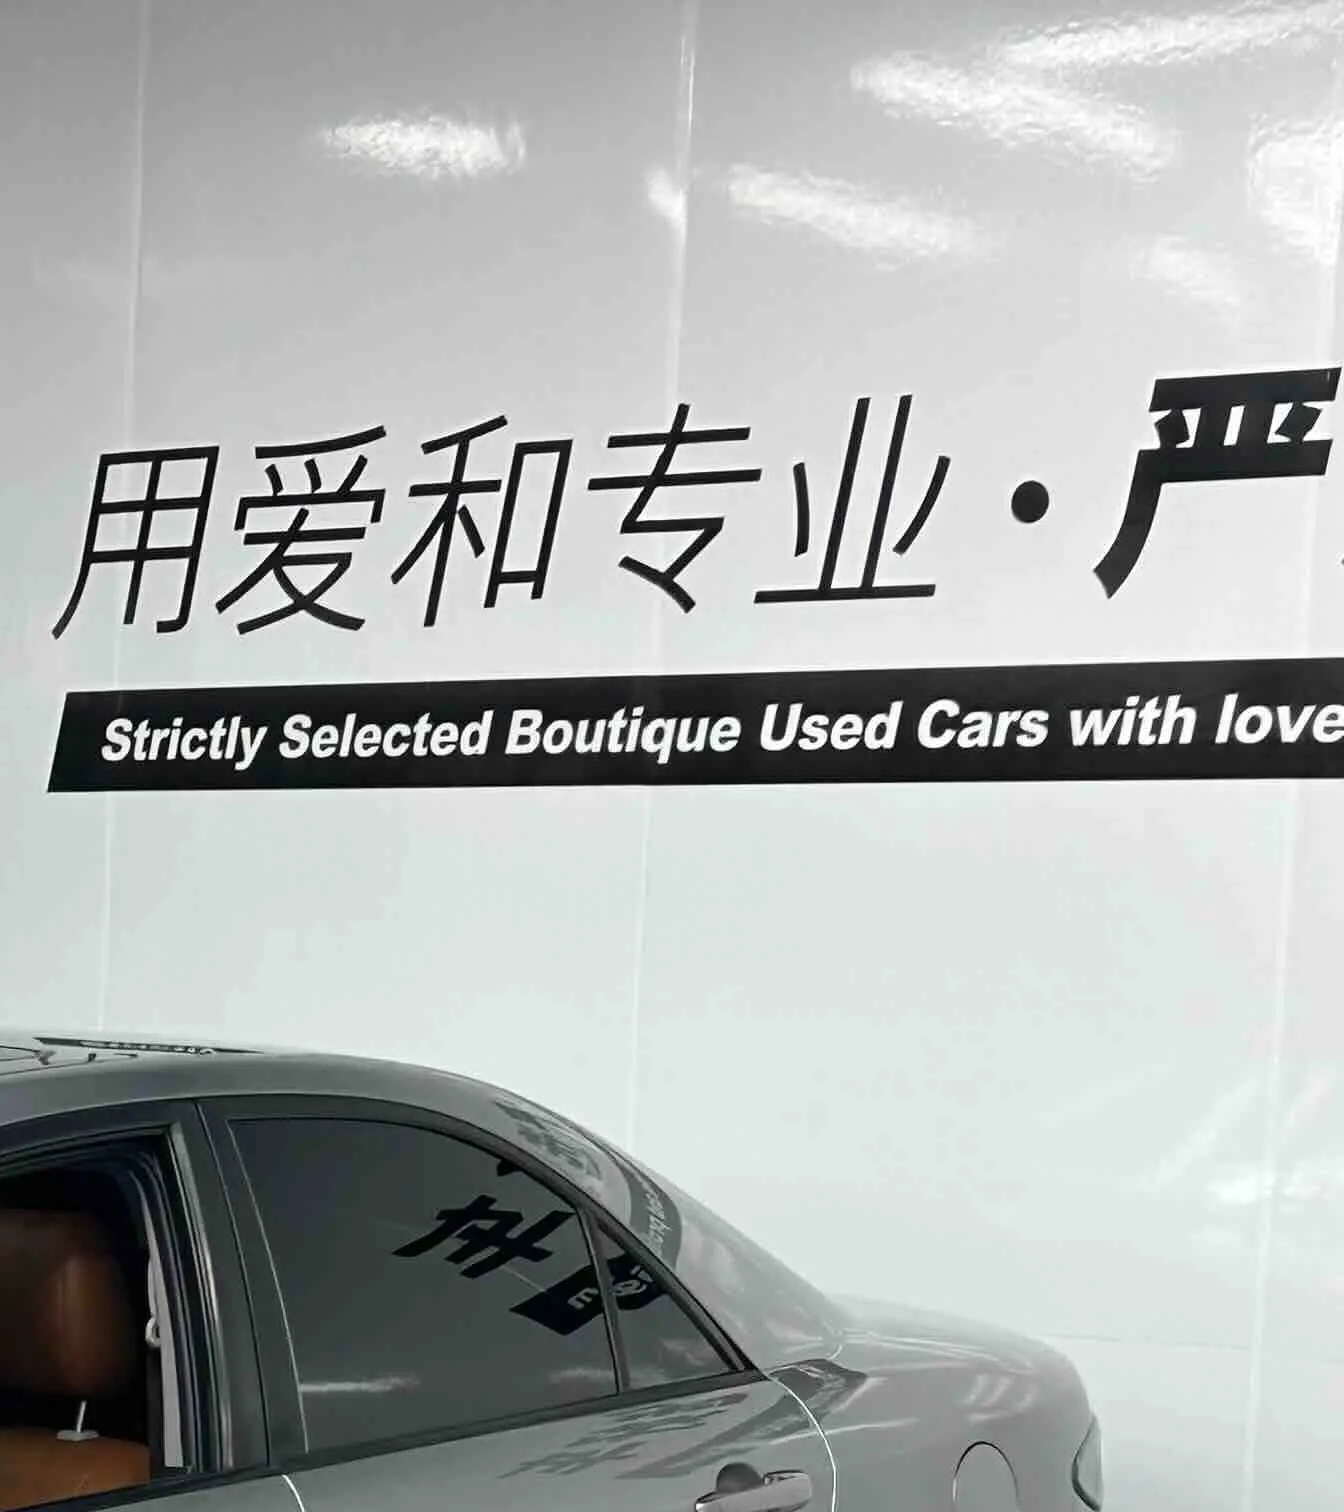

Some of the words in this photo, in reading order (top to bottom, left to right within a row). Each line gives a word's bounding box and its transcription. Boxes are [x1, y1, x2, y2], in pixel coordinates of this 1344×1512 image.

[101, 715, 268, 771] Strictly
[279, 709, 494, 759] Selected
[504, 705, 742, 765] Boutique
[760, 700, 904, 751] Used
[917, 699, 1049, 749] Cars
[1069, 694, 1197, 747] with
[1214, 693, 1344, 744] love
